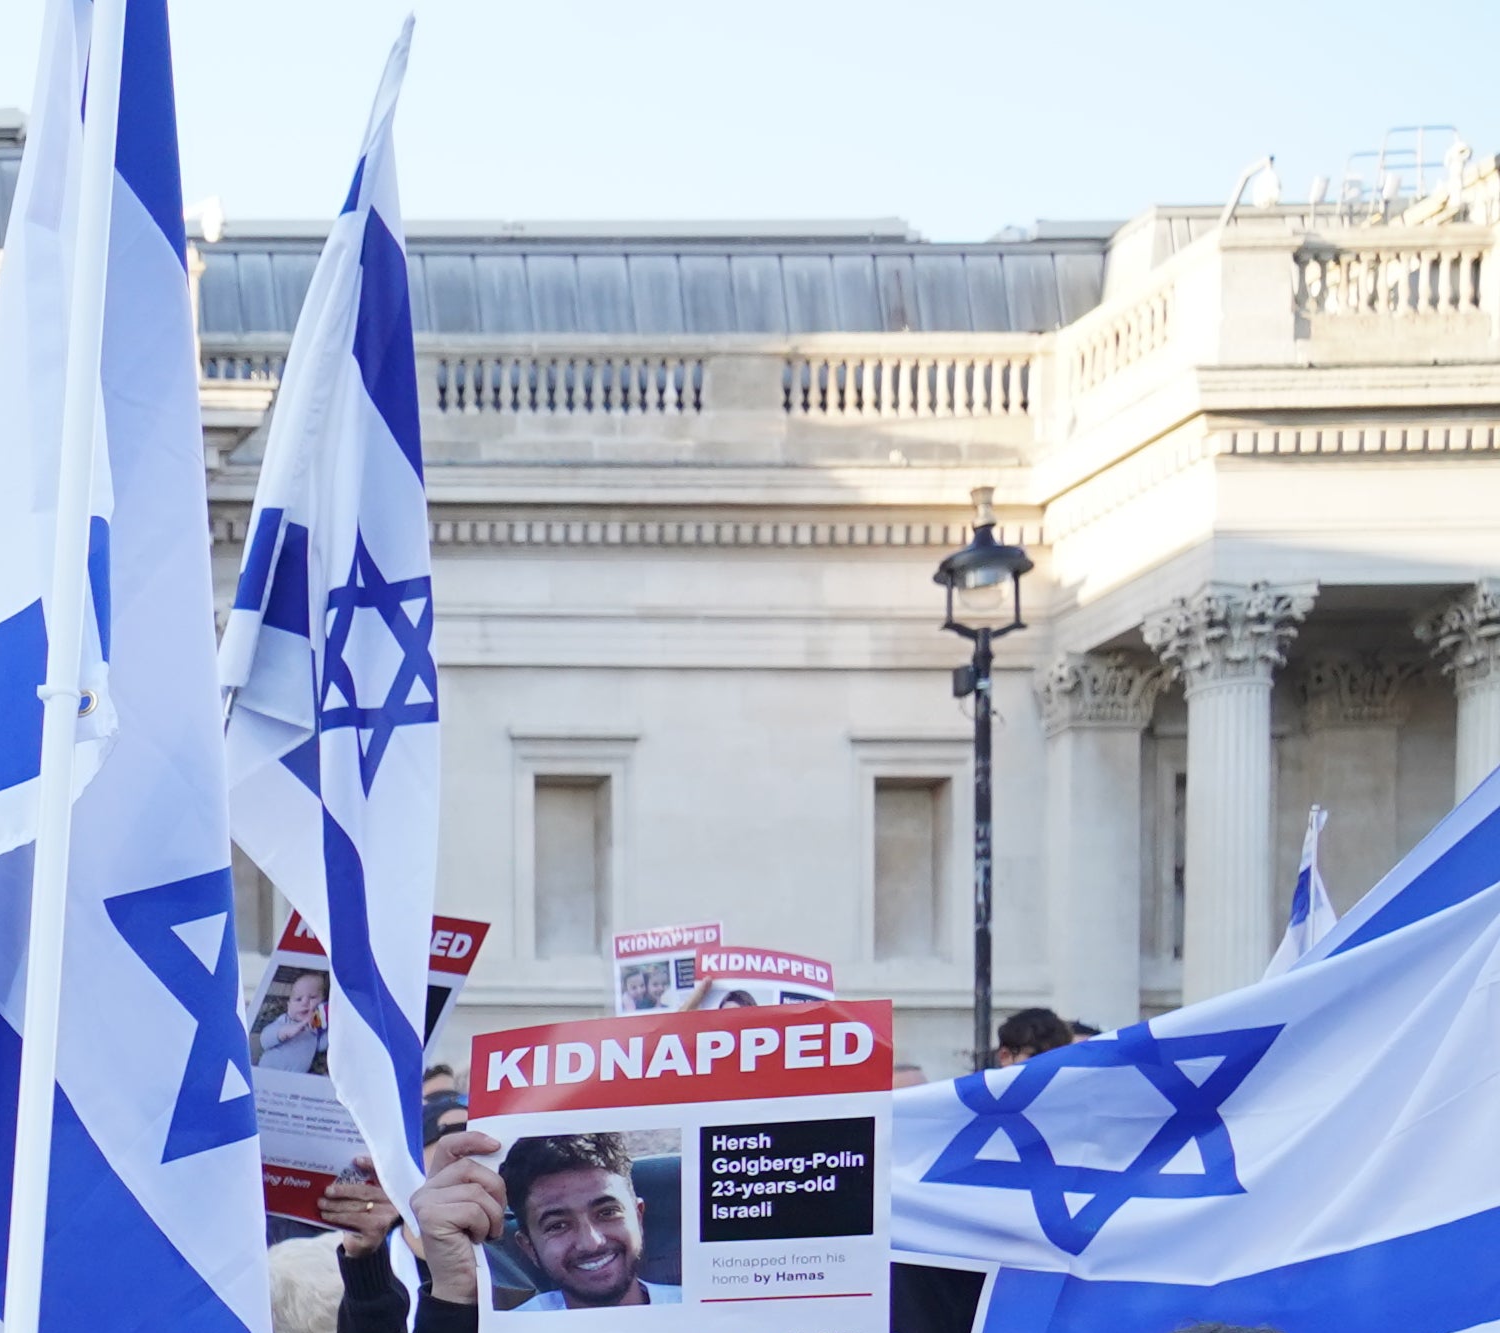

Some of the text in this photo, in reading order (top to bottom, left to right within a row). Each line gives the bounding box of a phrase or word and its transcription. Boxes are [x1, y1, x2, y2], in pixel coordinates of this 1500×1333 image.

[701, 953, 829, 984] KIDNAPPED
[487, 1021, 873, 1091] KIDNAPPED
[712, 1133, 771, 1152] Hersh
[712, 1151, 864, 1177] Golgberg-Polin
[711, 1175, 836, 1200] 23-years-old
[712, 1201, 772, 1220] Israeli
[712, 1253, 846, 1268] Kidnapped from his
[712, 1271, 825, 1286] home by Hamas
